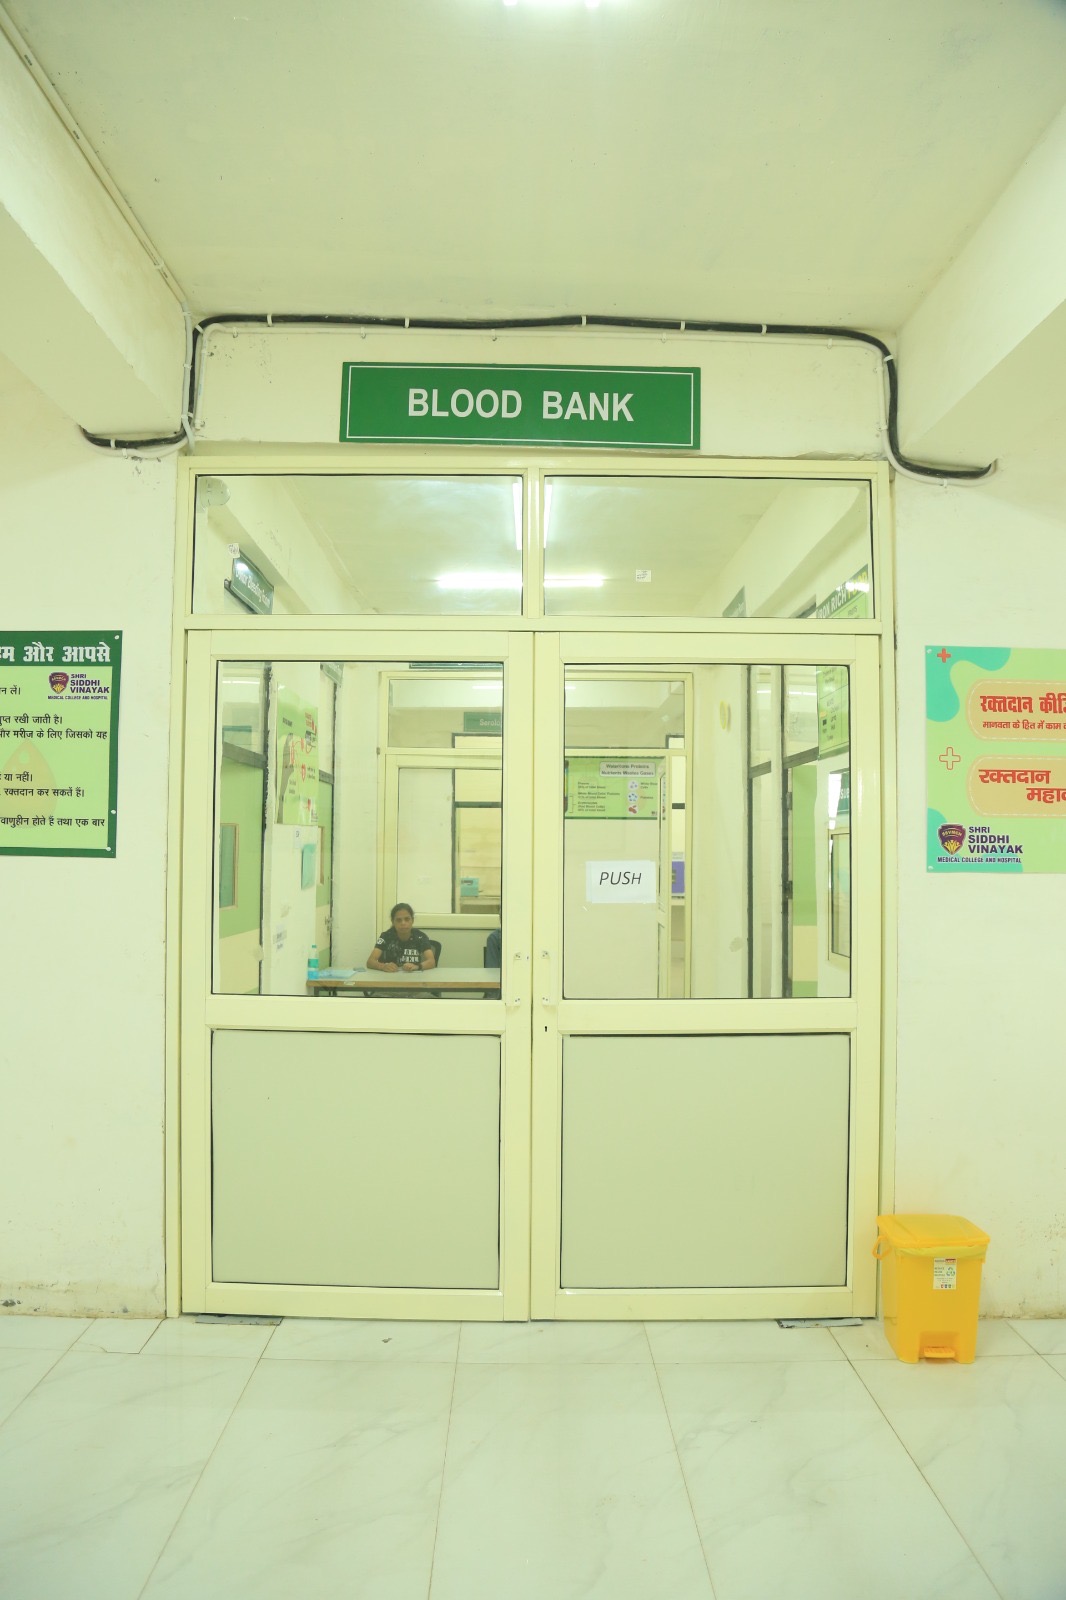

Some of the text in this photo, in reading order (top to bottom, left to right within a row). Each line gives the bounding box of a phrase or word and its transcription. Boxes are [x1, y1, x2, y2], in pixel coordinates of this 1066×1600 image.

[408, 388, 634, 422] BLOOD BANK
[831, 589, 846, 612] RICH
[23, 641, 54, 663] और
[62, 641, 111, 663] आपसे
[70, 679, 100, 687] SIDDHI
[70, 686, 110, 694] VINAYAK
[980, 695, 1034, 713] रक्तदान
[14, 713, 29, 724] रखी
[32, 713, 51, 724] जाती
[1012, 719, 1021, 729] के
[1022, 719, 1036, 730] हित
[1037, 720, 1045, 730] में
[13, 728, 34, 738] मरीज
[36, 729, 44, 738] के
[47, 729, 63, 739] लिए
[65, 729, 93, 739] जिसको
[96, 731, 108, 740] यह
[4, 773, 13, 782] या
[979, 769, 1051, 785] रक्तदान
[4, 788, 34, 797] रक्तदान
[37, 788, 50, 797] कर
[32, 814, 46, 827] होते
[57, 818, 73, 827] तथा
[76, 818, 89, 828] एक
[92, 818, 106, 827] बार
[968, 826, 990, 834] SHRI
[968, 834, 1010, 844] SIDDHI
[968, 844, 1023, 854] VINAYAK
[599, 871, 642, 886] PUSH
